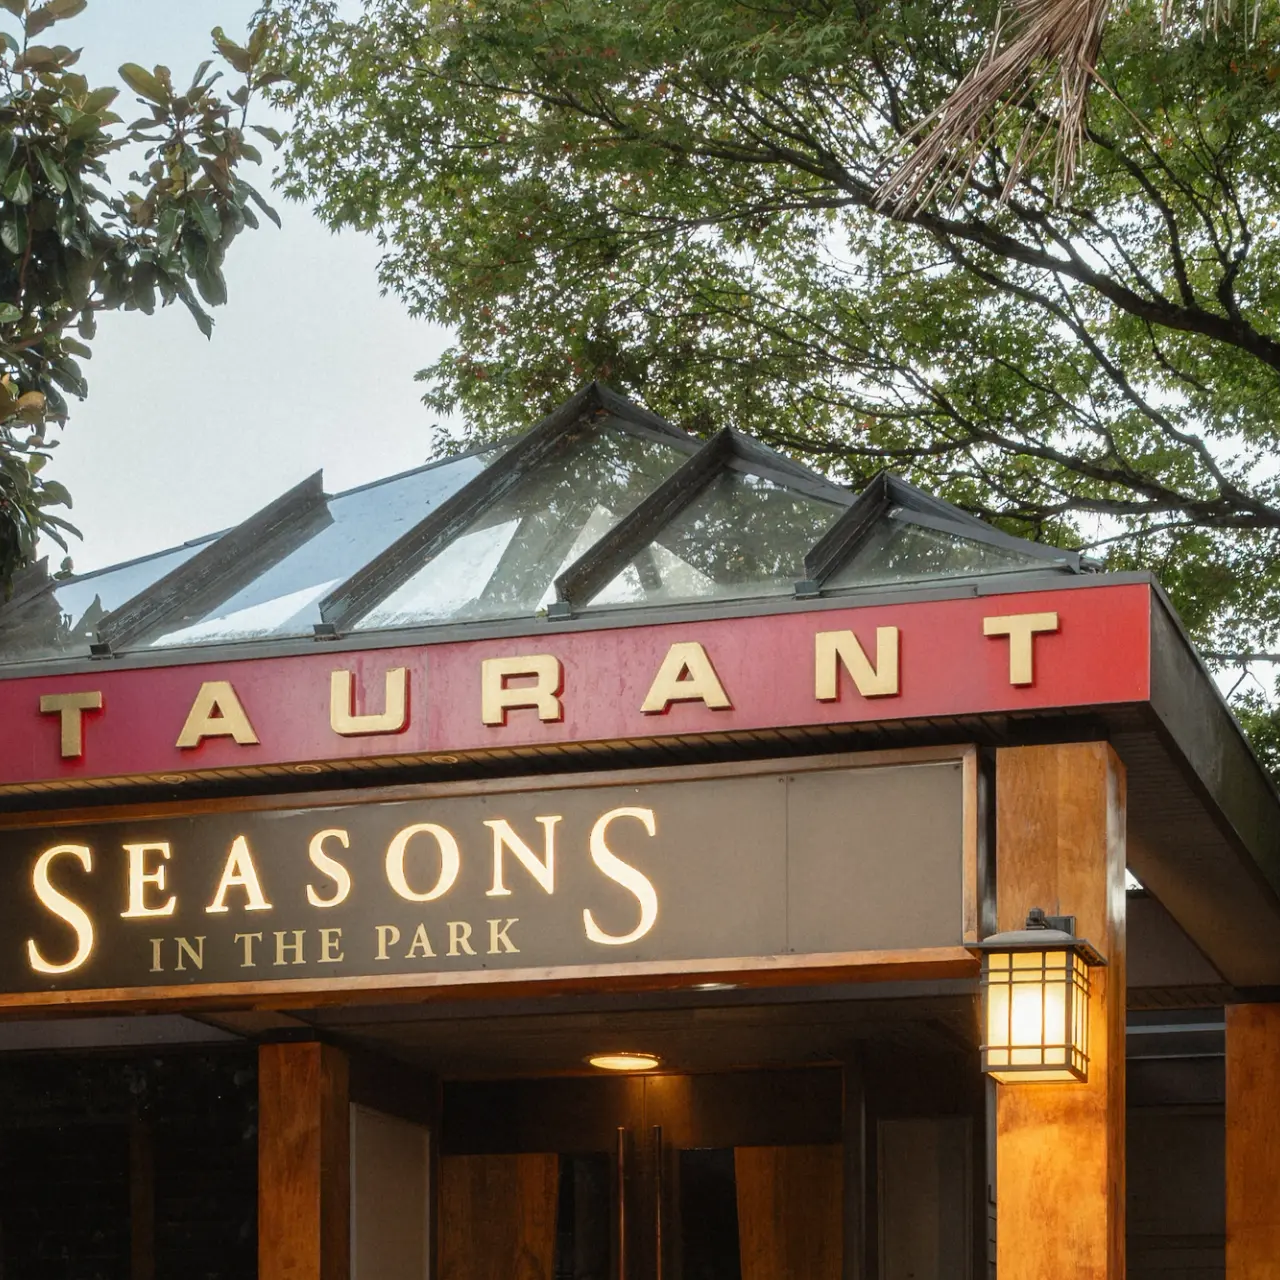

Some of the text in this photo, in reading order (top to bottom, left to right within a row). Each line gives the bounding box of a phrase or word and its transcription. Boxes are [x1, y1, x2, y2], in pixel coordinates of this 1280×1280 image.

[27, 806, 659, 974] SEASONS
[149, 917, 521, 972] IN THE PARK
